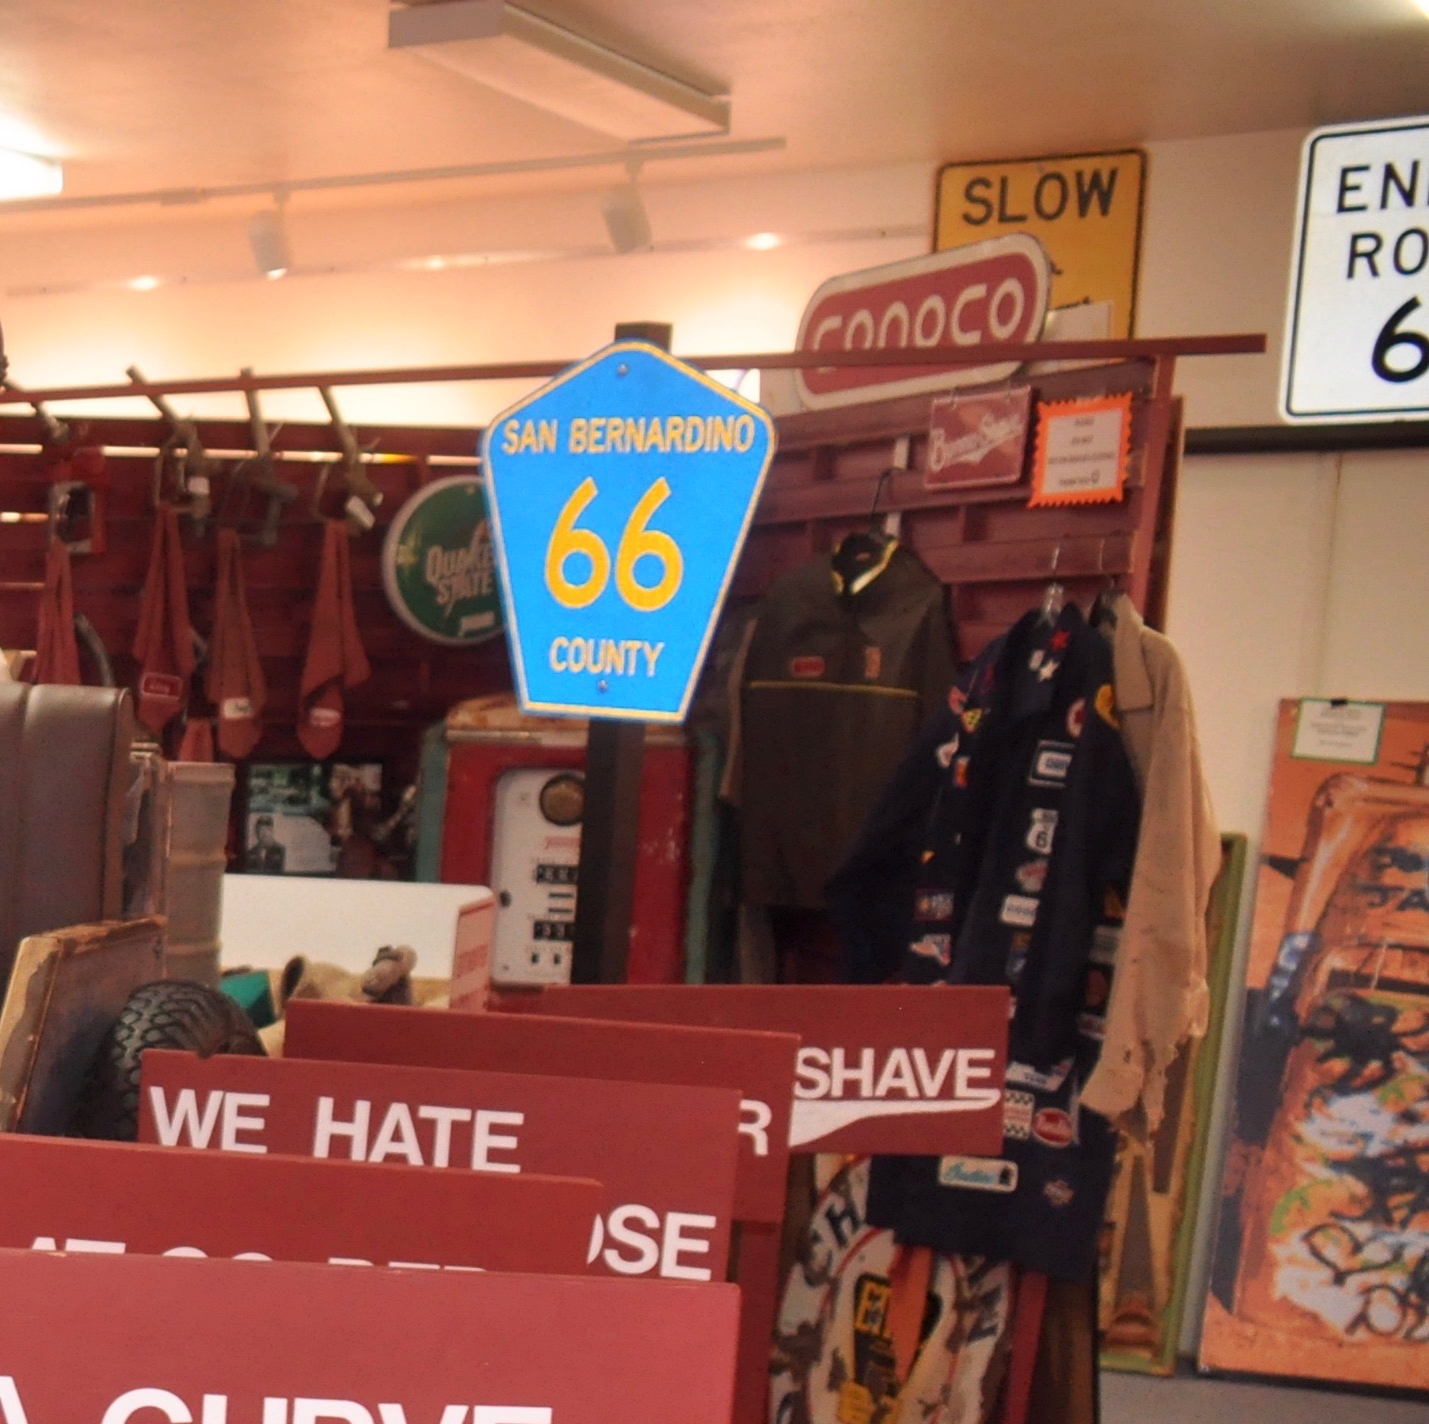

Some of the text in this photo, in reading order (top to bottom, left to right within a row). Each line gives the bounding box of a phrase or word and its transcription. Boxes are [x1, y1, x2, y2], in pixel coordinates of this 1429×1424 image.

[961, 167, 1120, 227] SLOW
[1337, 162, 1429, 214] EN
[501, 414, 755, 456] SAN BERNARDINO
[544, 475, 685, 612] 66
[549, 636, 665, 677] COUNTY
[795, 1047, 996, 1100] SHAVE
[149, 1085, 525, 1174] WE HATE
